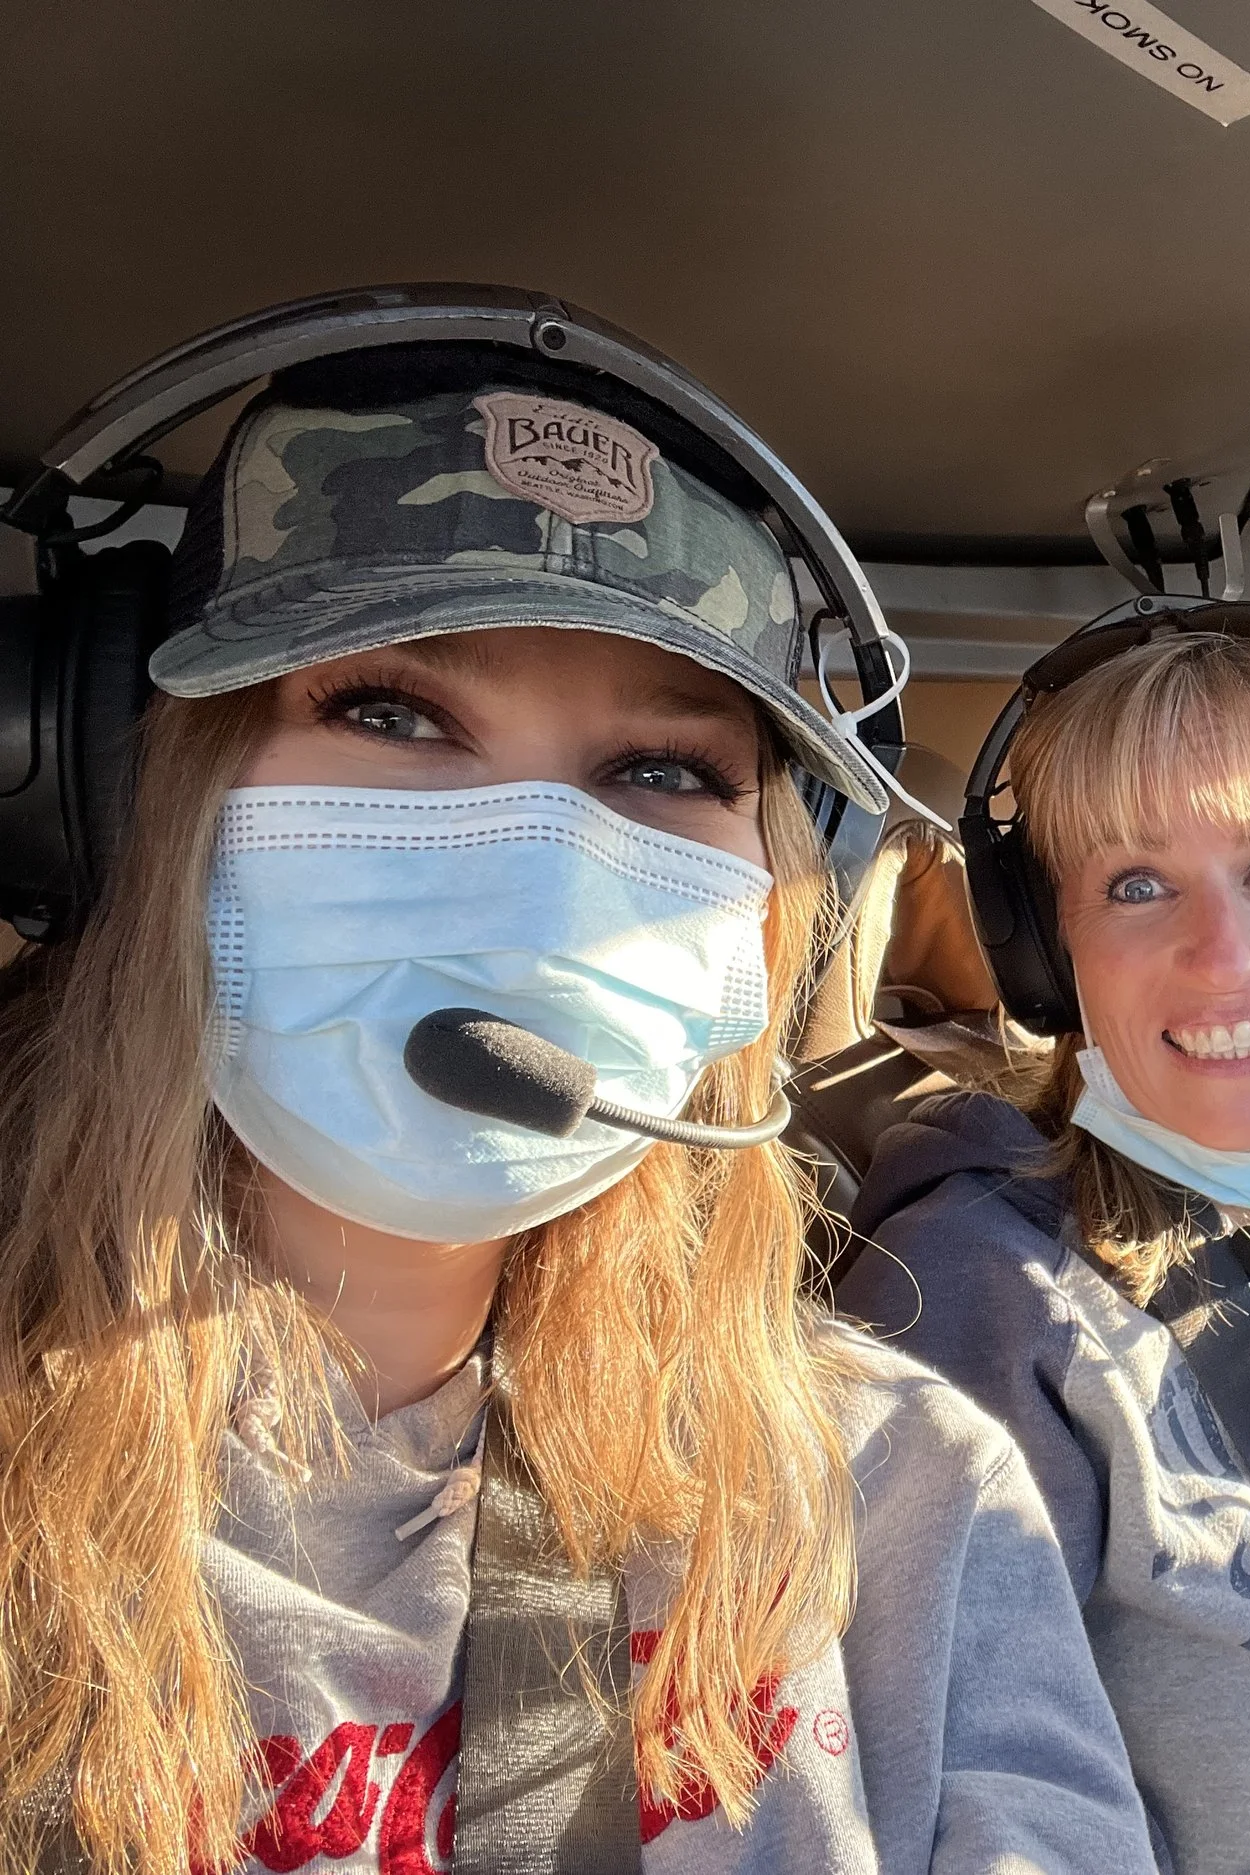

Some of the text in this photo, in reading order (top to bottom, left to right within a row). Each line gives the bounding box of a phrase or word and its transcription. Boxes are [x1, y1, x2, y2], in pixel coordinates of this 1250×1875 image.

[1177, 63, 1224, 92] NO
[508, 418, 637, 490] BAUER
[543, 442, 609, 465] SINCE 1920
